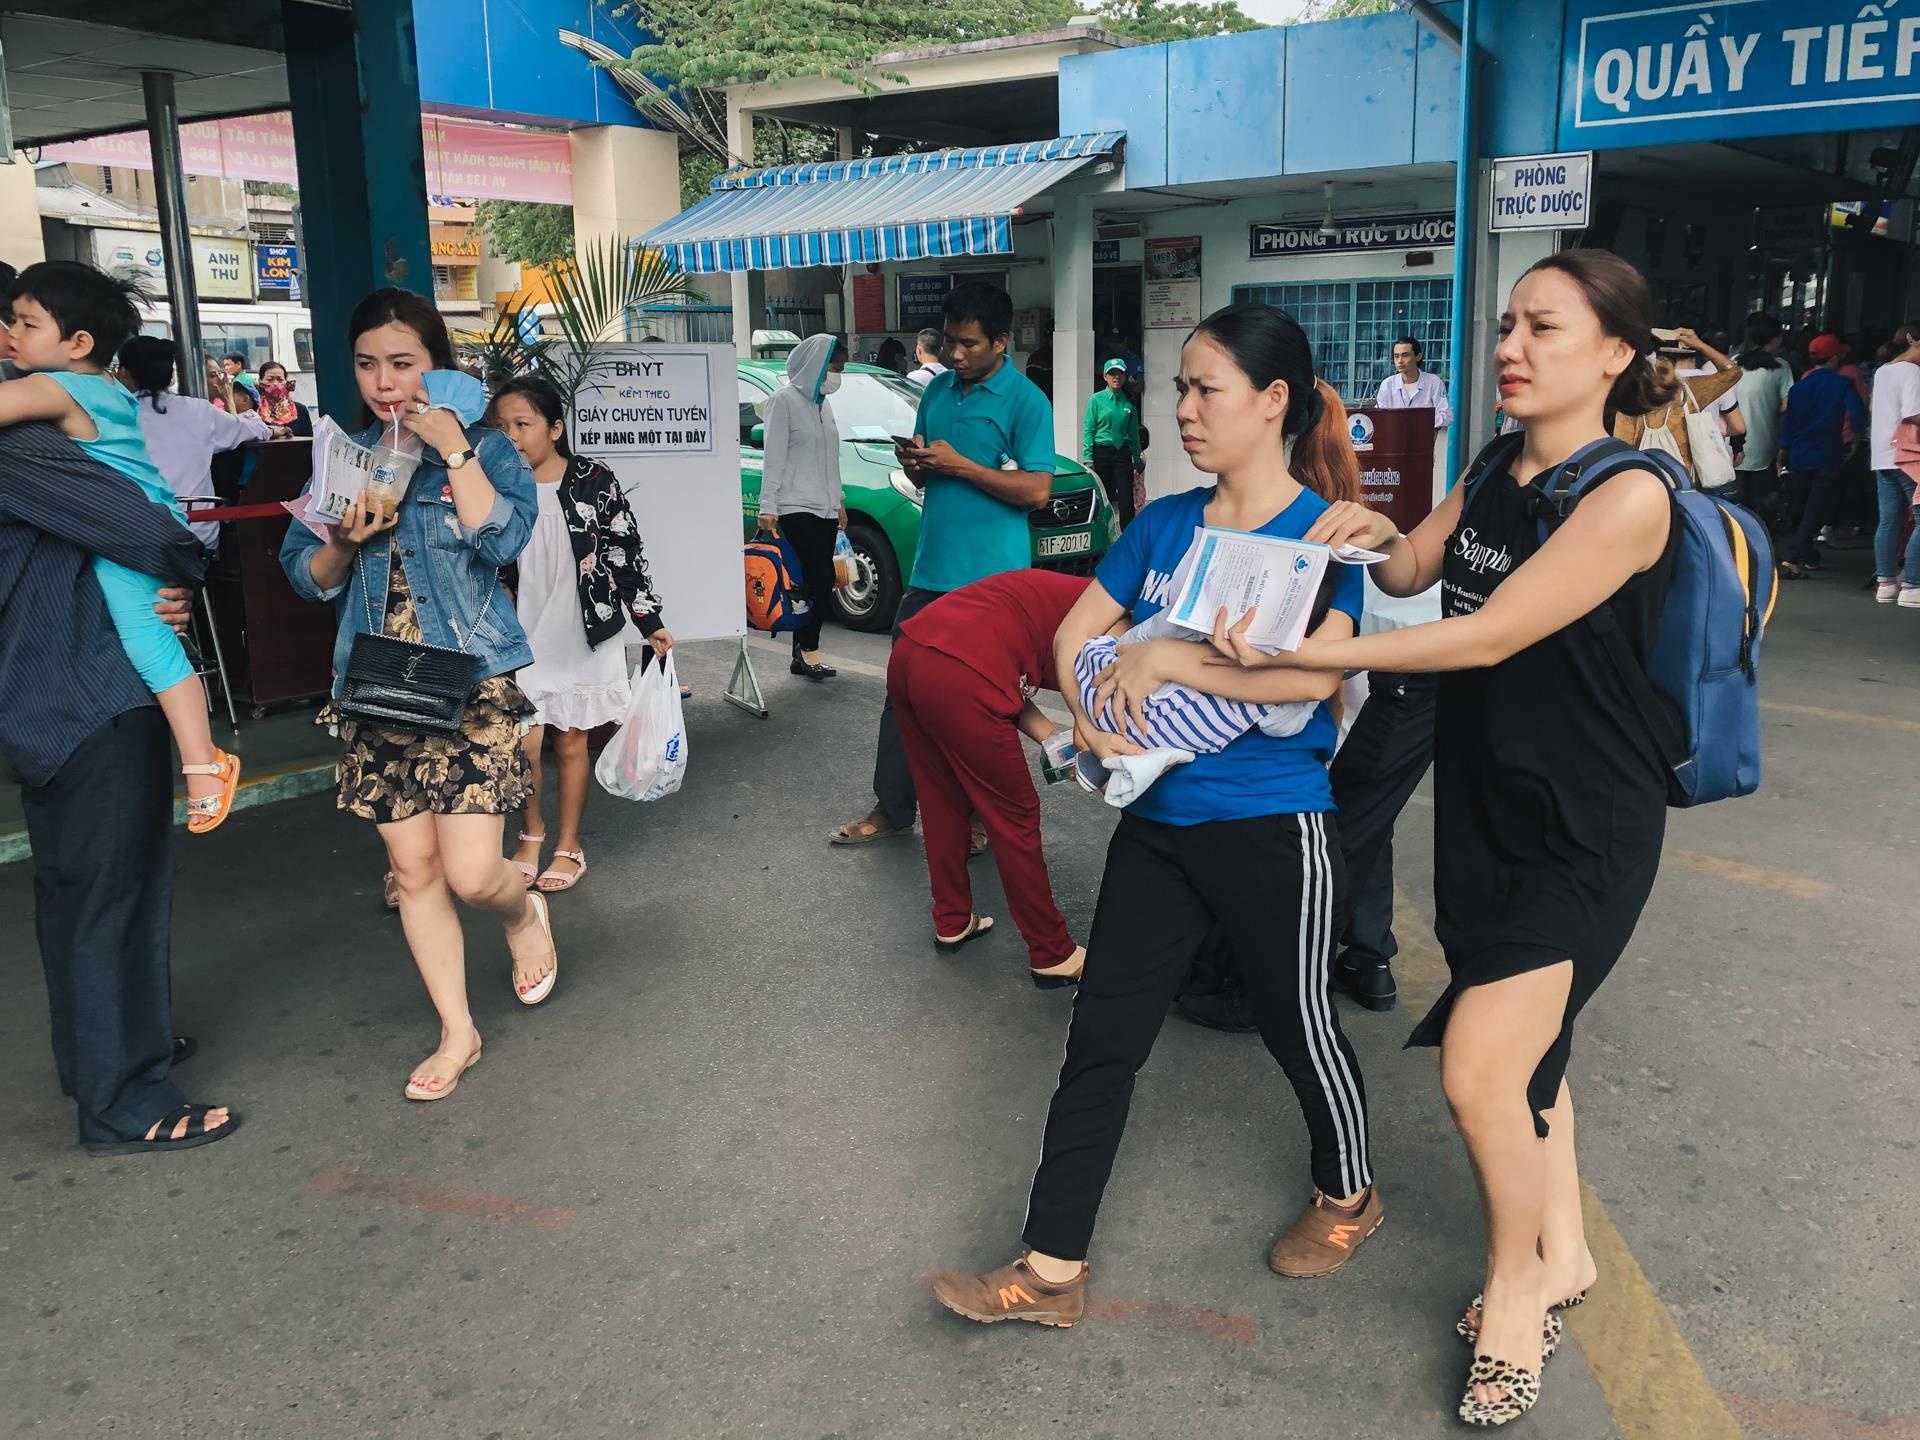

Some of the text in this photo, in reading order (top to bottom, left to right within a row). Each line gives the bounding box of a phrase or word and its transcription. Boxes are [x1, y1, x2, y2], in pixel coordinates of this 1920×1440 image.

[1594, 14, 1761, 112] QUẦY
[1514, 163, 1566, 188] PHÒNG
[1496, 190, 1583, 219] TRỰC DƯỢC
[208, 252, 240, 266] ANH
[269, 248, 288, 256] SHOP
[267, 257, 291, 267] KIM
[210, 268, 240, 281] THƯ
[261, 267, 289, 278] LON
[615, 362, 664, 377] BHYT
[645, 389, 671, 400] THEO
[580, 427, 601, 445] XẾP
[604, 429, 635, 445] HÀNG
[638, 429, 662, 447] MỘT
[666, 430, 682, 447] TẠI
[1454, 527, 1512, 575] Sappho
